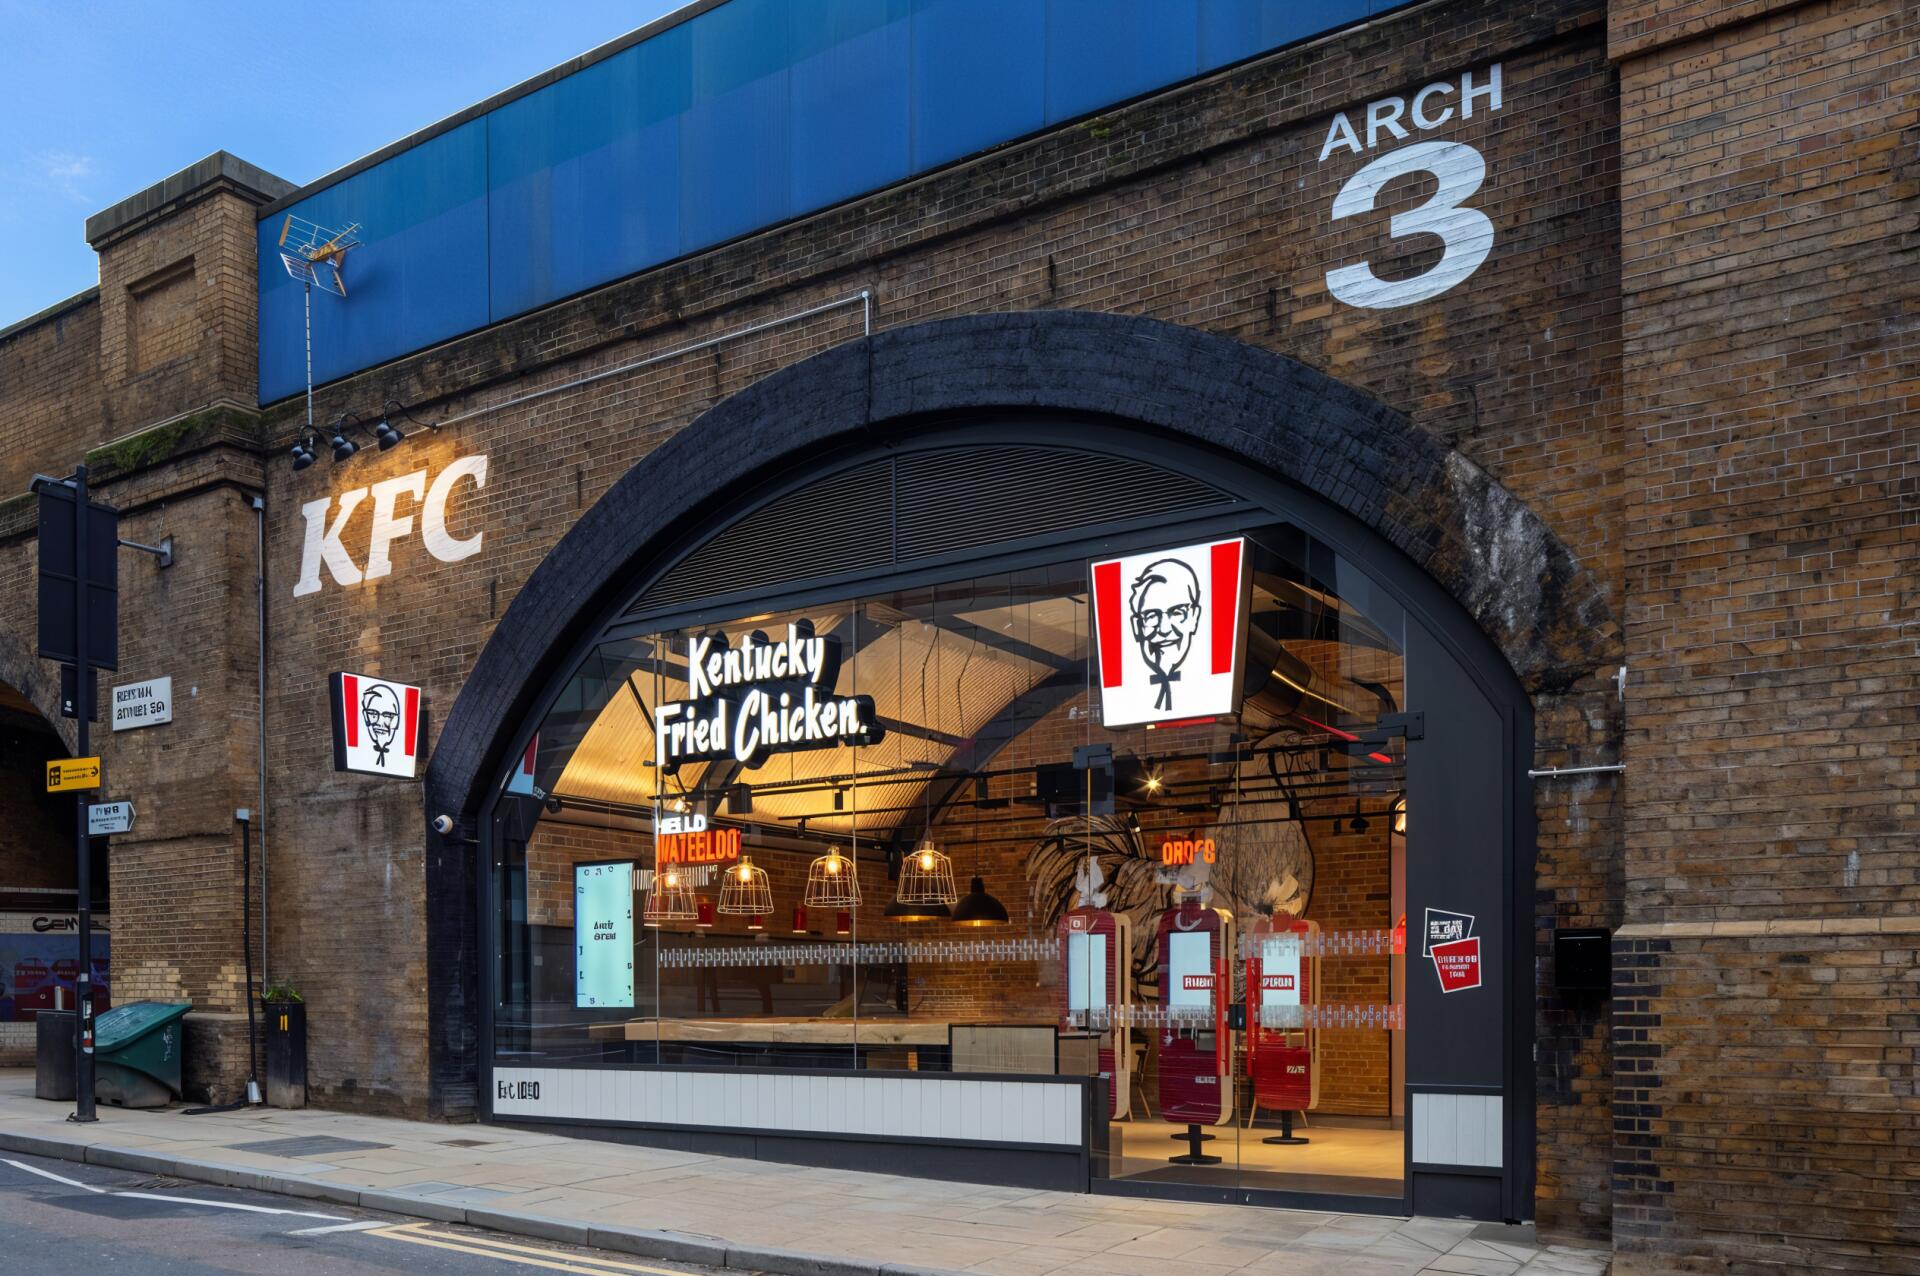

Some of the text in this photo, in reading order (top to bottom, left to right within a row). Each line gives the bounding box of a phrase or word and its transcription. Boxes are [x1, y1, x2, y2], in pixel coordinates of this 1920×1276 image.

[1318, 62, 1503, 162] ARCH
[1325, 140, 1495, 309] 3
[293, 455, 488, 598] KFC
[689, 623, 824, 700] Kentucky
[655, 698, 727, 766] Fried
